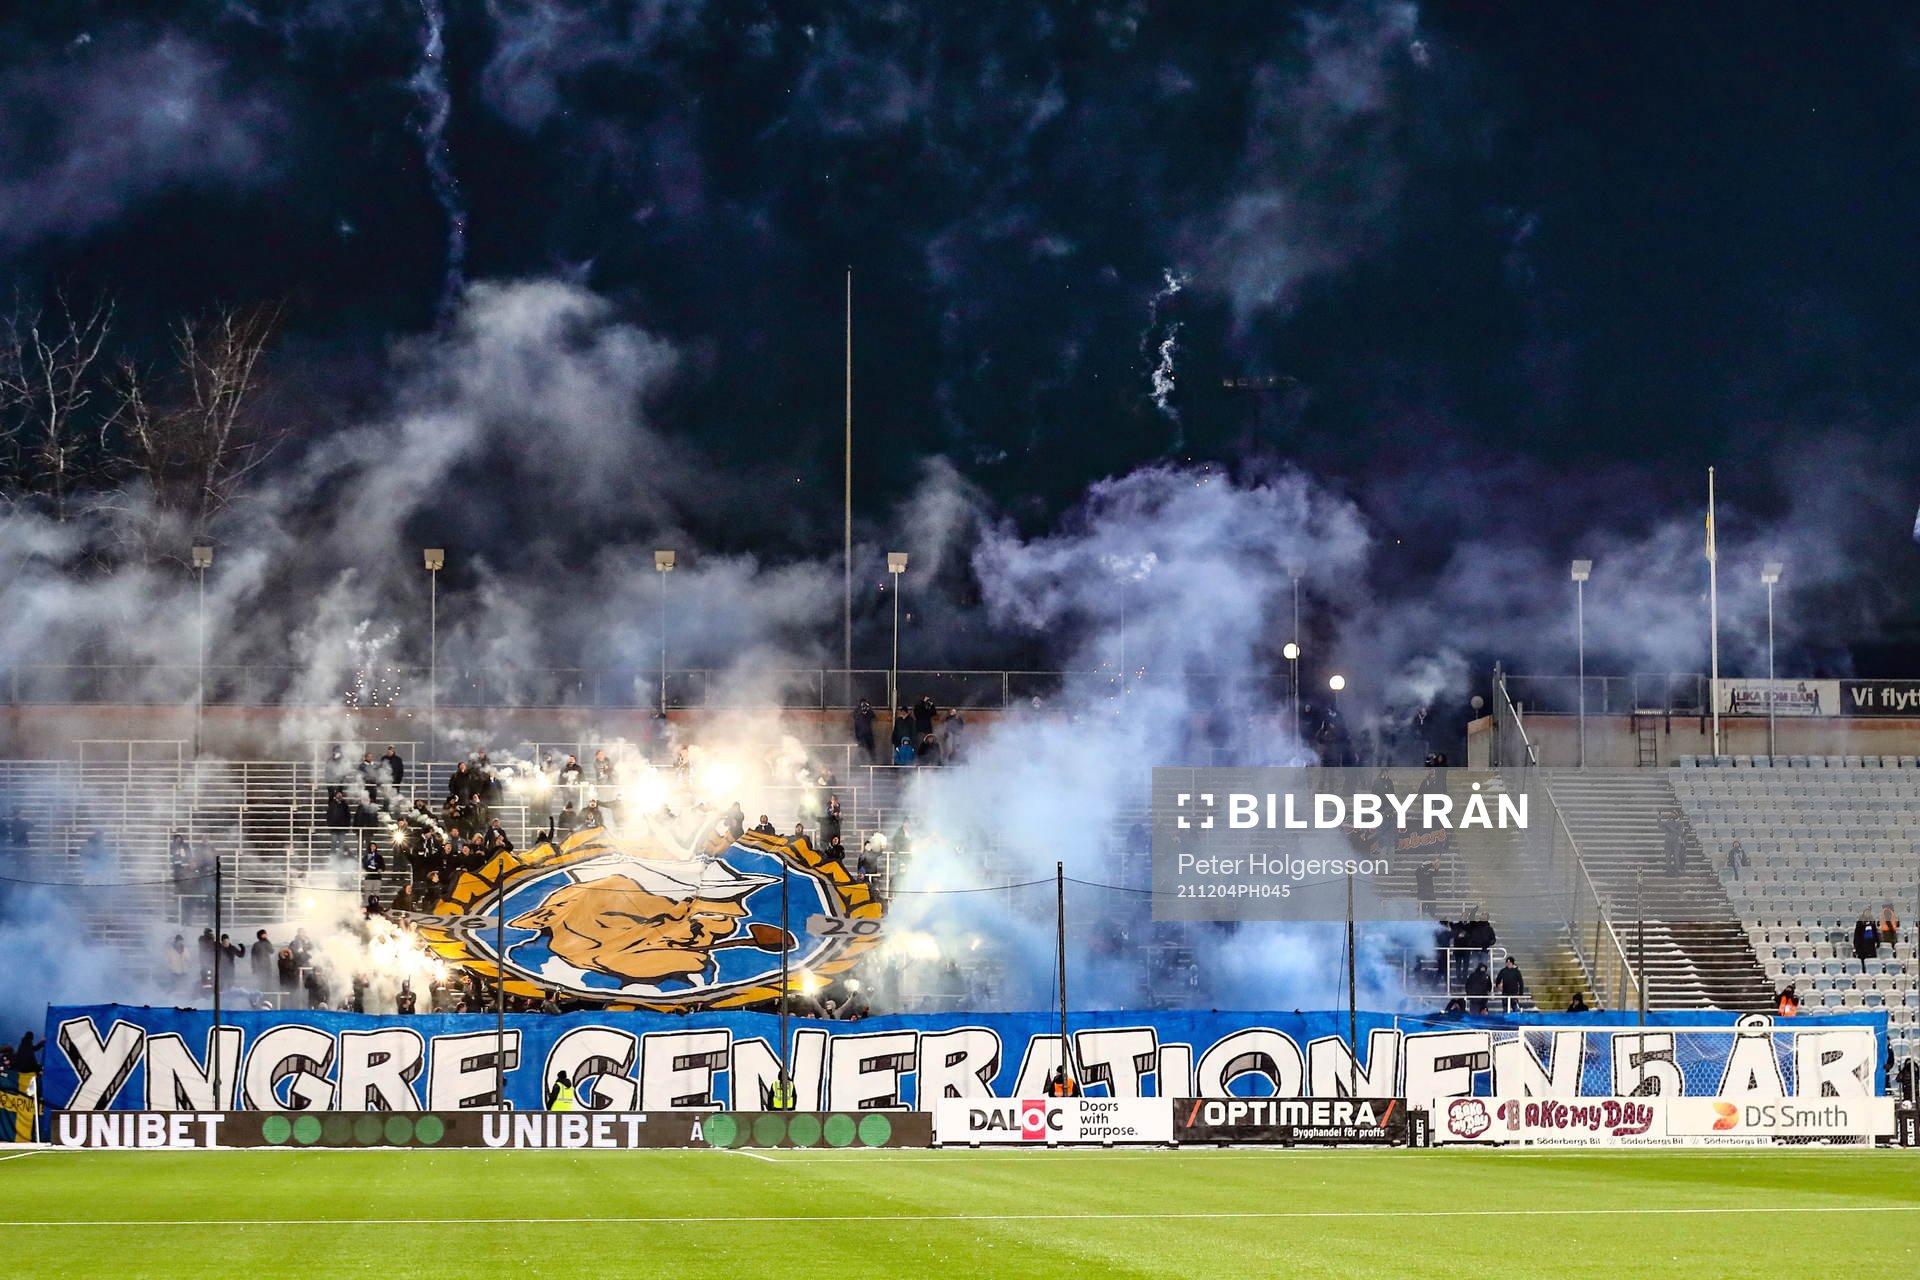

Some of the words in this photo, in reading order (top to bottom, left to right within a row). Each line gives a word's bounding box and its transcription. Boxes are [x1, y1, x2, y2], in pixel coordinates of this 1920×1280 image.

[1851, 687, 1873, 706] Vi
[57, 1016, 522, 1111] YNGRE
[543, 1024, 1585, 1111] GENERATIONEN
[1612, 1031, 1686, 1098] 5
[1718, 1013, 1877, 1098] ÅR
[1080, 1100, 1118, 1112] Doors
[1204, 1101, 1377, 1126] OPTIMERA
[969, 1107, 1063, 1131] DALOC
[1080, 1113, 1109, 1124] with
[1745, 1105, 1776, 1127] DS
[1781, 1104, 1847, 1127] Smith
[59, 1113, 225, 1147] UNIBET
[482, 1113, 648, 1147] UNIBET
[1080, 1126, 1138, 1139] purpose.
[1293, 1127, 1342, 1139] Bygghandel
[1344, 1127, 1357, 1138] för
[1359, 1127, 1385, 1139] proffs
[1536, 1137, 1588, 1146] Söderbergs
[1621, 1137, 1672, 1146] Söderbergs
[1703, 1137, 1756, 1146] Söderbergs
